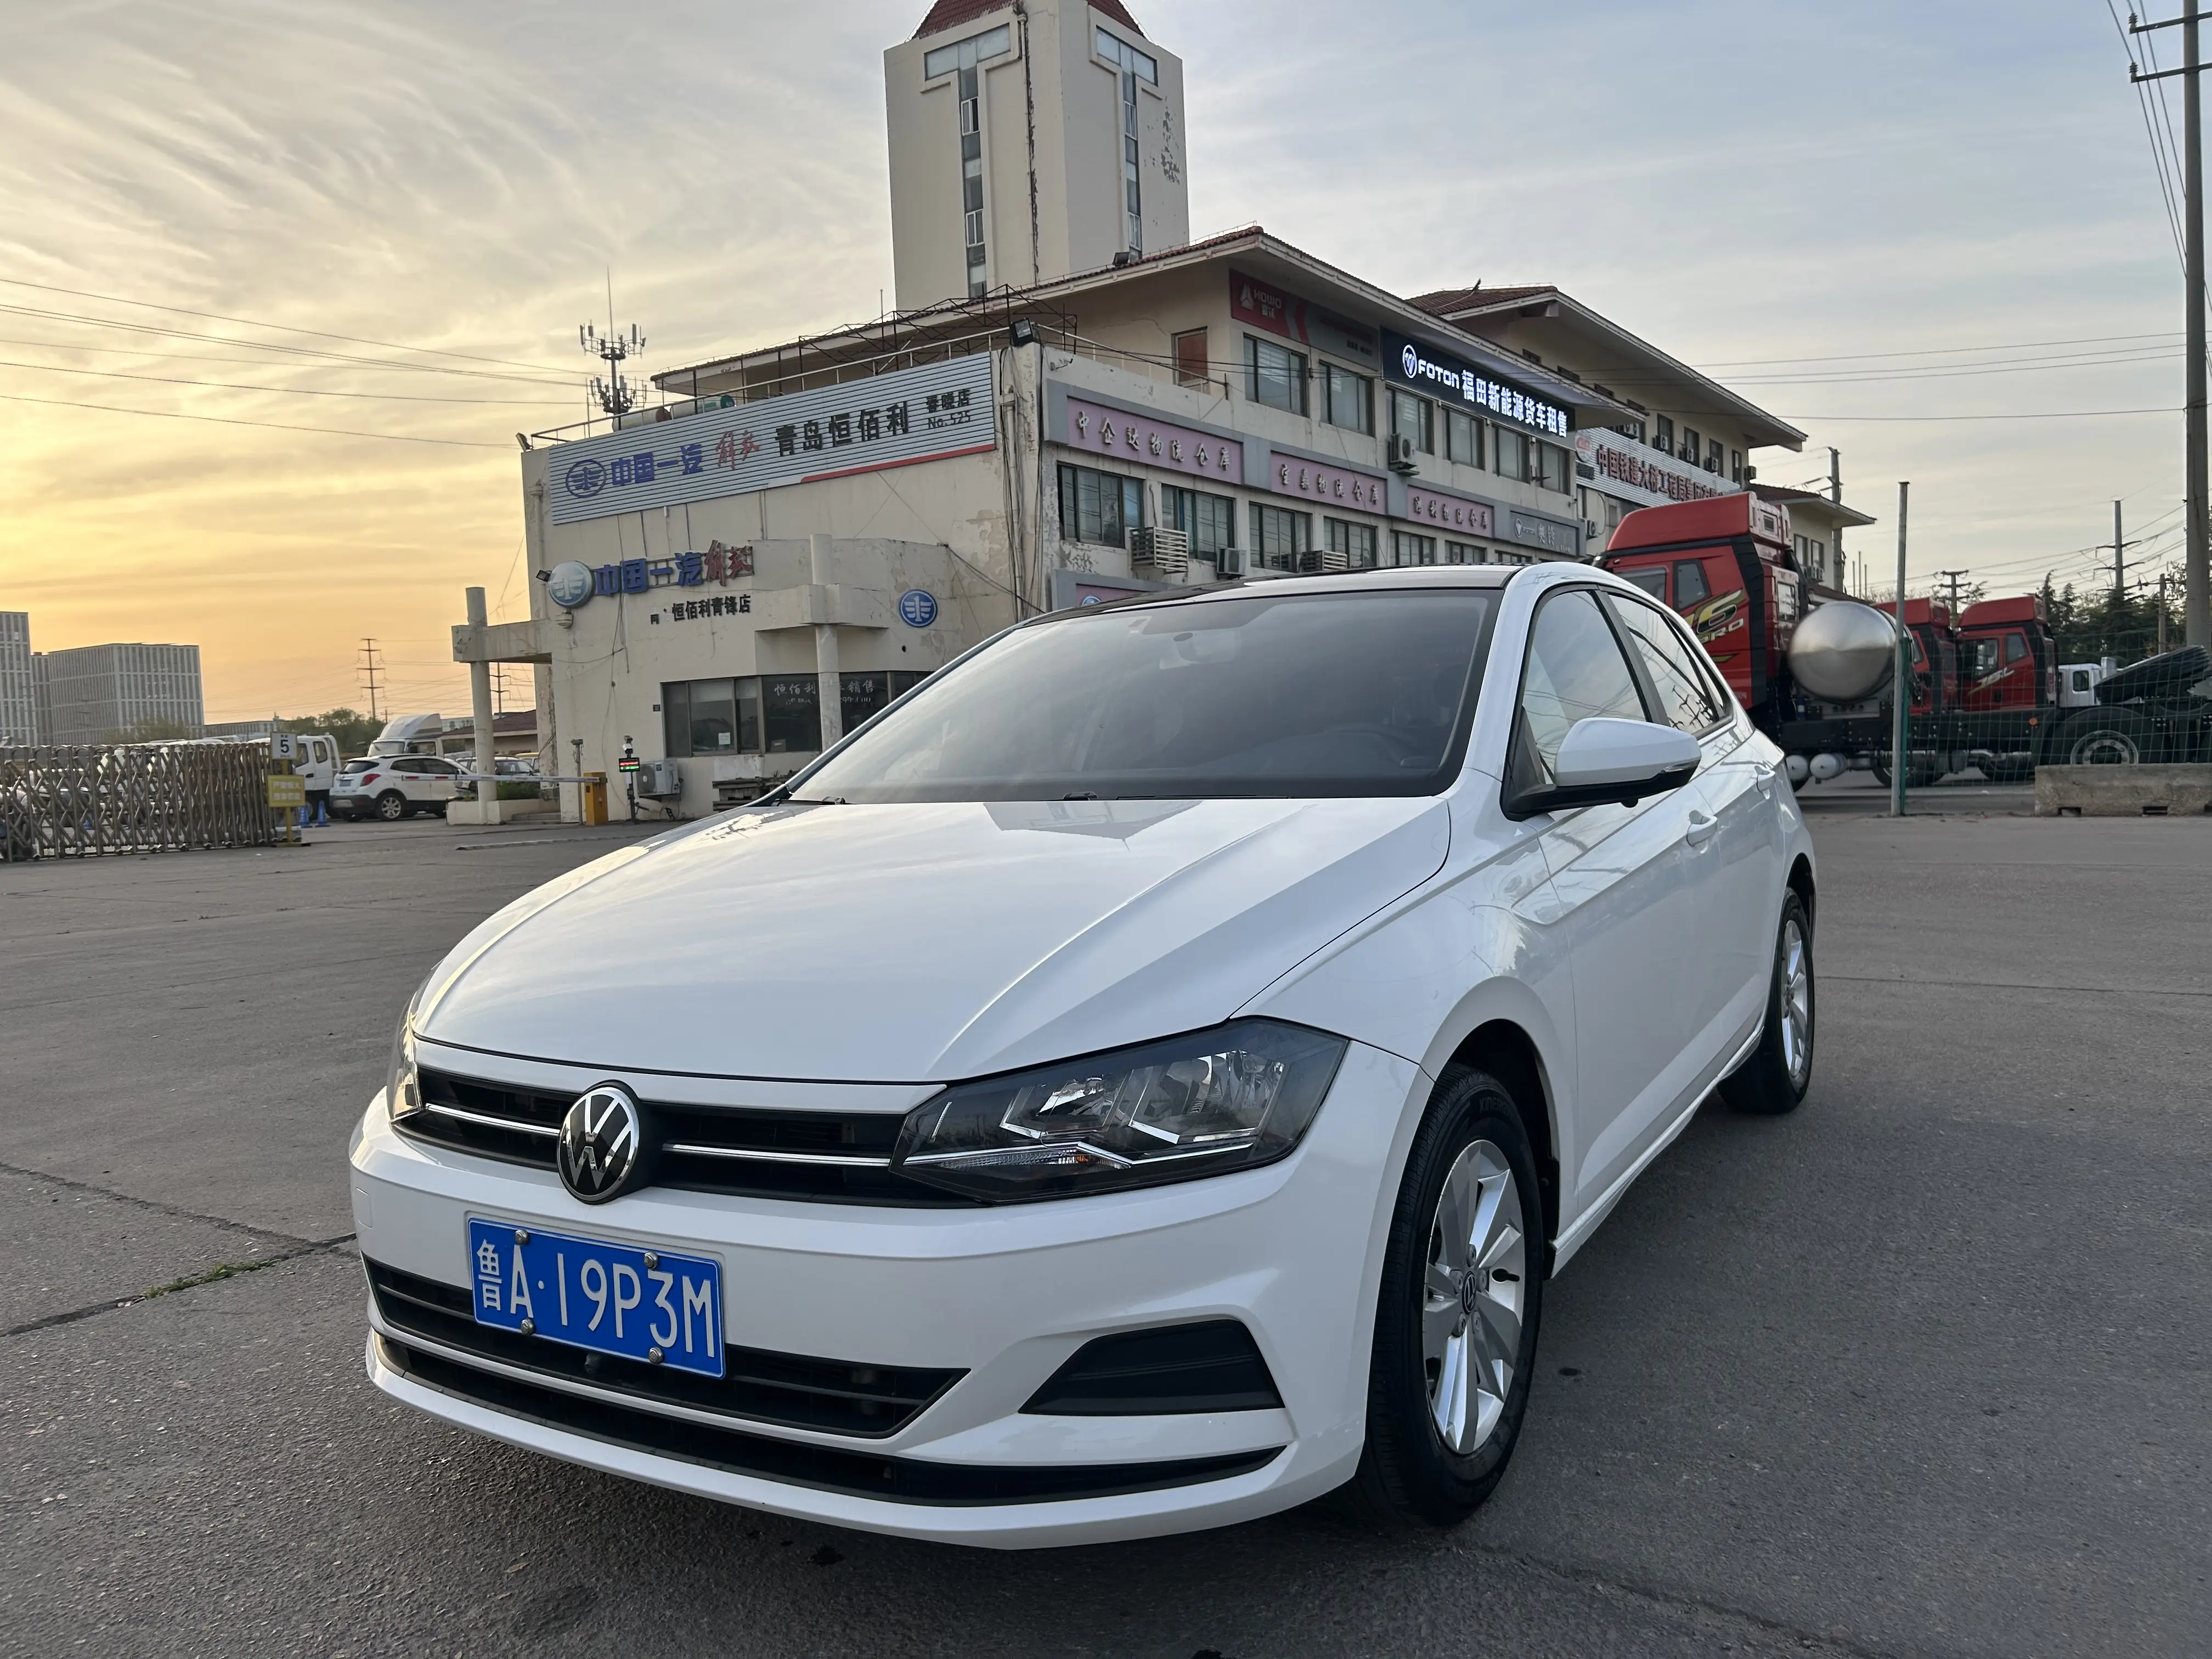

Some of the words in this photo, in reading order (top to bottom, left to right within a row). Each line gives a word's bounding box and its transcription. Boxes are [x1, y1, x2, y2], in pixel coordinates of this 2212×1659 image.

[1254, 289, 1282, 309] HOWO
[927, 410, 971, 430] No.525
[1418, 359, 1460, 389] FOTON
[1462, 369, 1567, 438] 福田新能源货车租售
[611, 443, 703, 486] 中国一汽
[775, 400, 909, 456] 青岛恒佰利
[1076, 411, 1231, 471] 中企达物流仓库
[1597, 444, 1723, 501] 中国铁建大桥工程局集团有
[595, 552, 704, 597] 中国一汽
[774, 682, 816, 696] 恒佰利
[840, 679, 875, 694] 销售
[280, 740, 289, 753] 5
